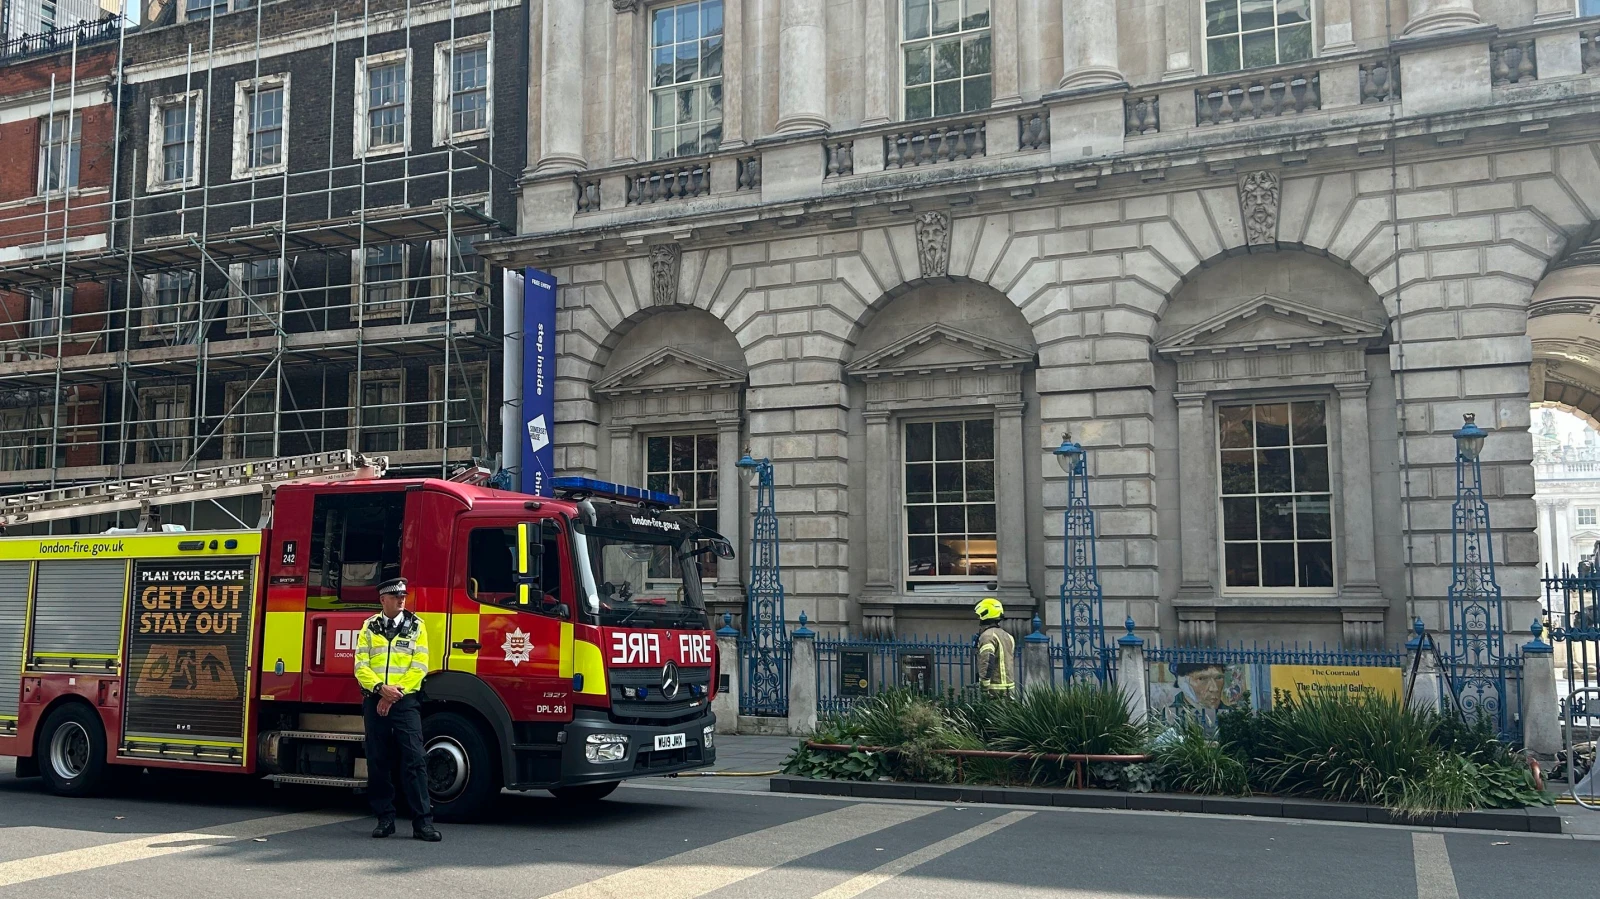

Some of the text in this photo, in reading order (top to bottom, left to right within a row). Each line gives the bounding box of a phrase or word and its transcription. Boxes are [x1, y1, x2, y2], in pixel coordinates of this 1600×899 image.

[536, 323, 544, 396] step inside
[631, 514, 681, 531] london-fire.gov.uk
[39, 540, 124, 555] london-fire.gov.uk
[287, 543, 293, 553] H
[283, 554, 295, 563] 242
[142, 570, 244, 581] PLAN YOUR ESCAPE
[141, 585, 244, 610] GET OUT
[139, 612, 242, 634] STAY OUT
[678, 634, 712, 664] FIRE
[1325, 669, 1360, 677] Courtauld
[1297, 682, 1310, 691] The
[536, 704, 567, 714] DPL 261
